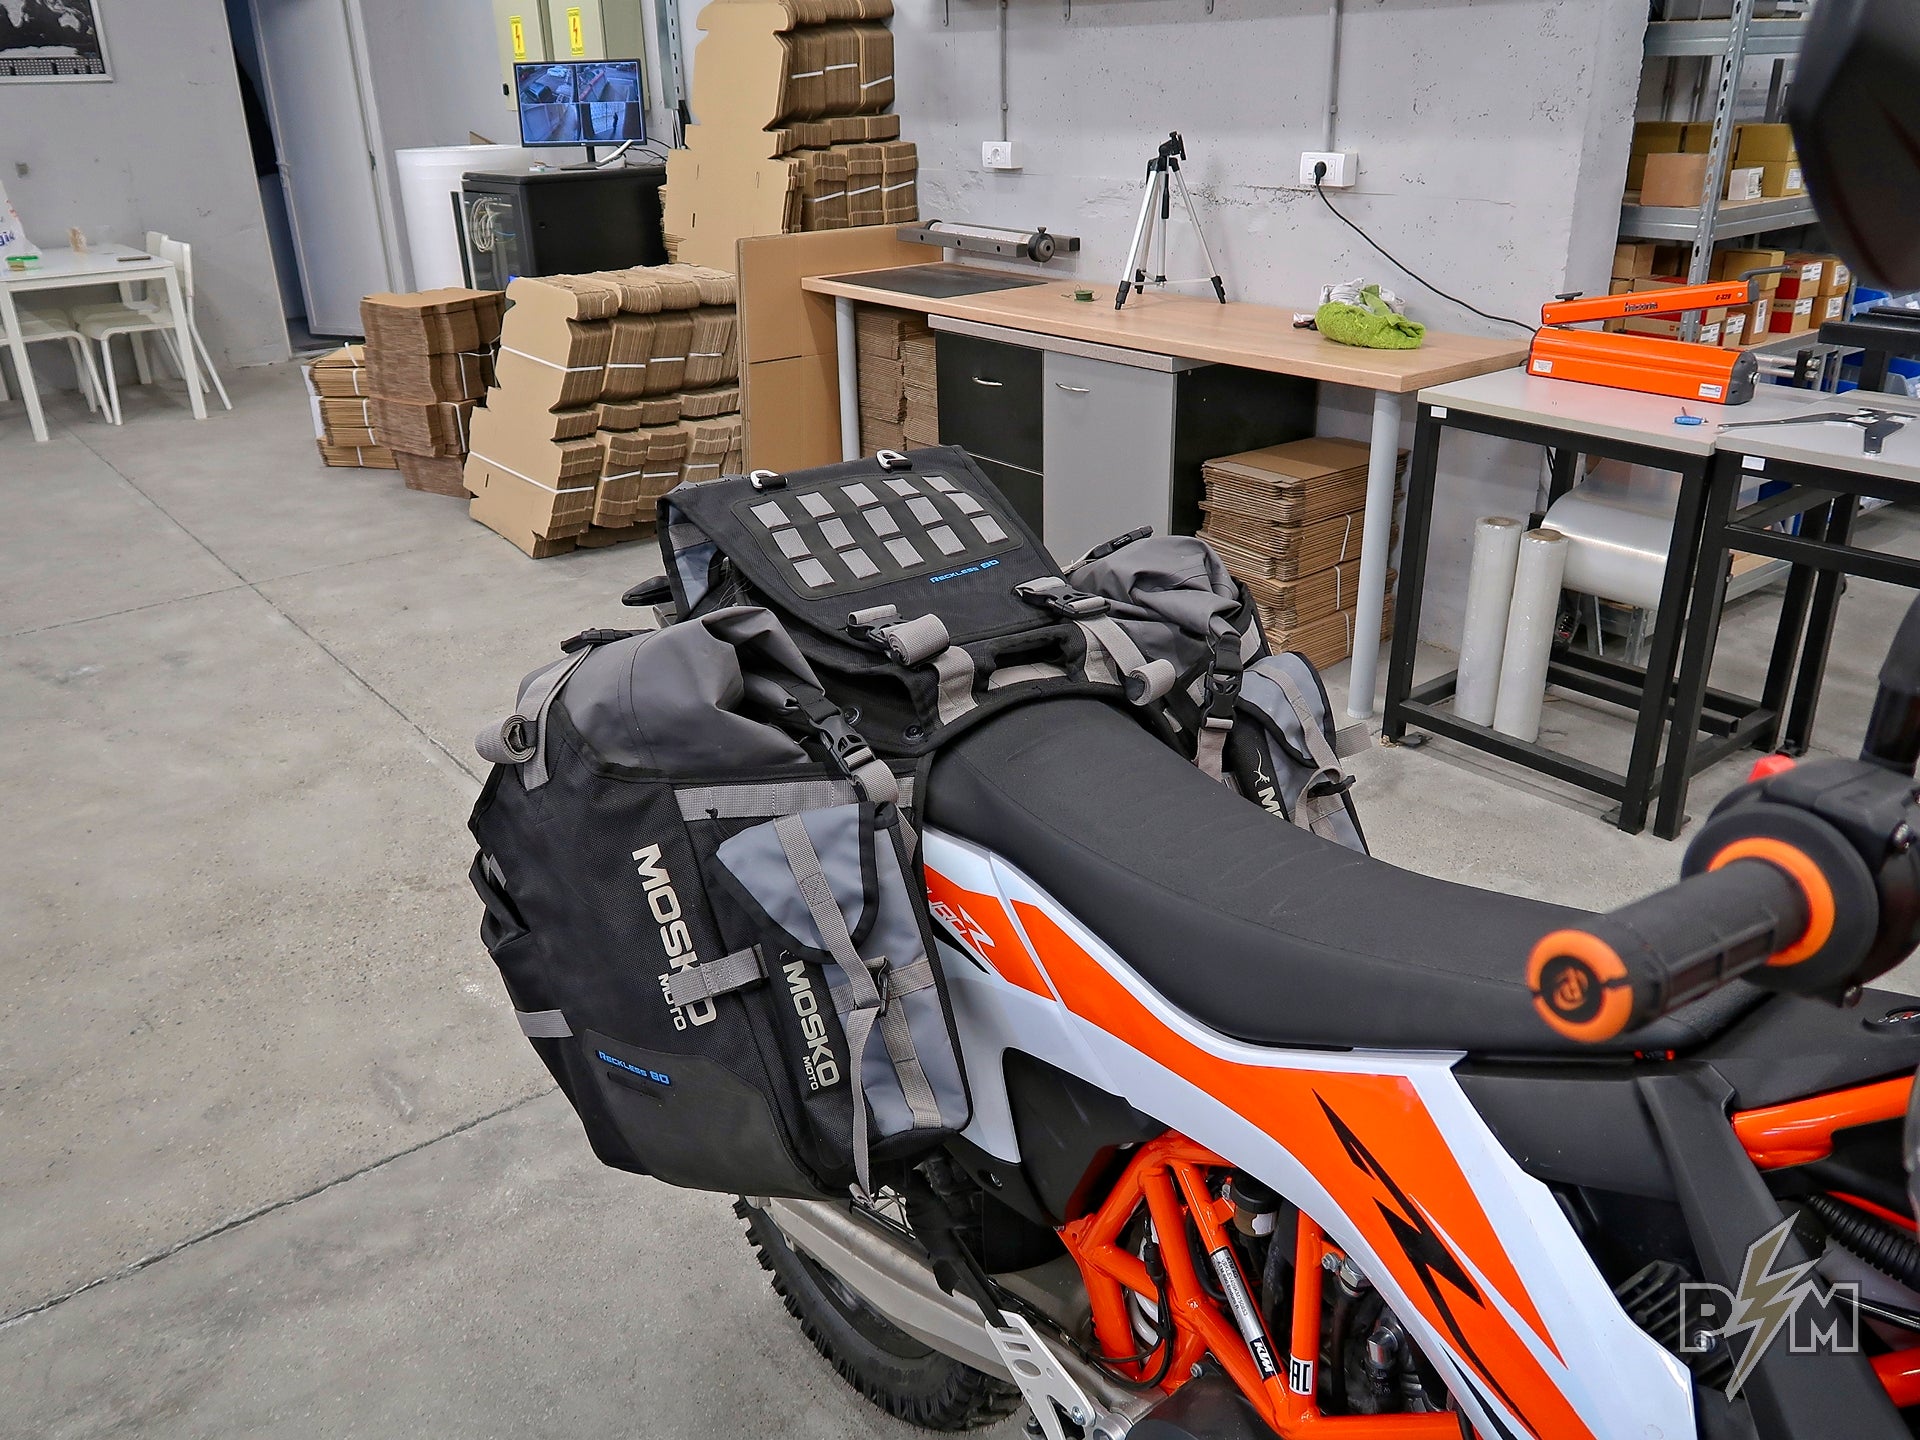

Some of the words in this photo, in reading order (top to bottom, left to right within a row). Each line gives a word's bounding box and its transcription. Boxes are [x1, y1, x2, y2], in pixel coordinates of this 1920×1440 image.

[782, 959, 841, 1087] MOSKO
[649, 1070, 670, 1085] 80
[802, 1055, 820, 1091] MOTO
[1253, 1341, 1274, 1373] KTM
